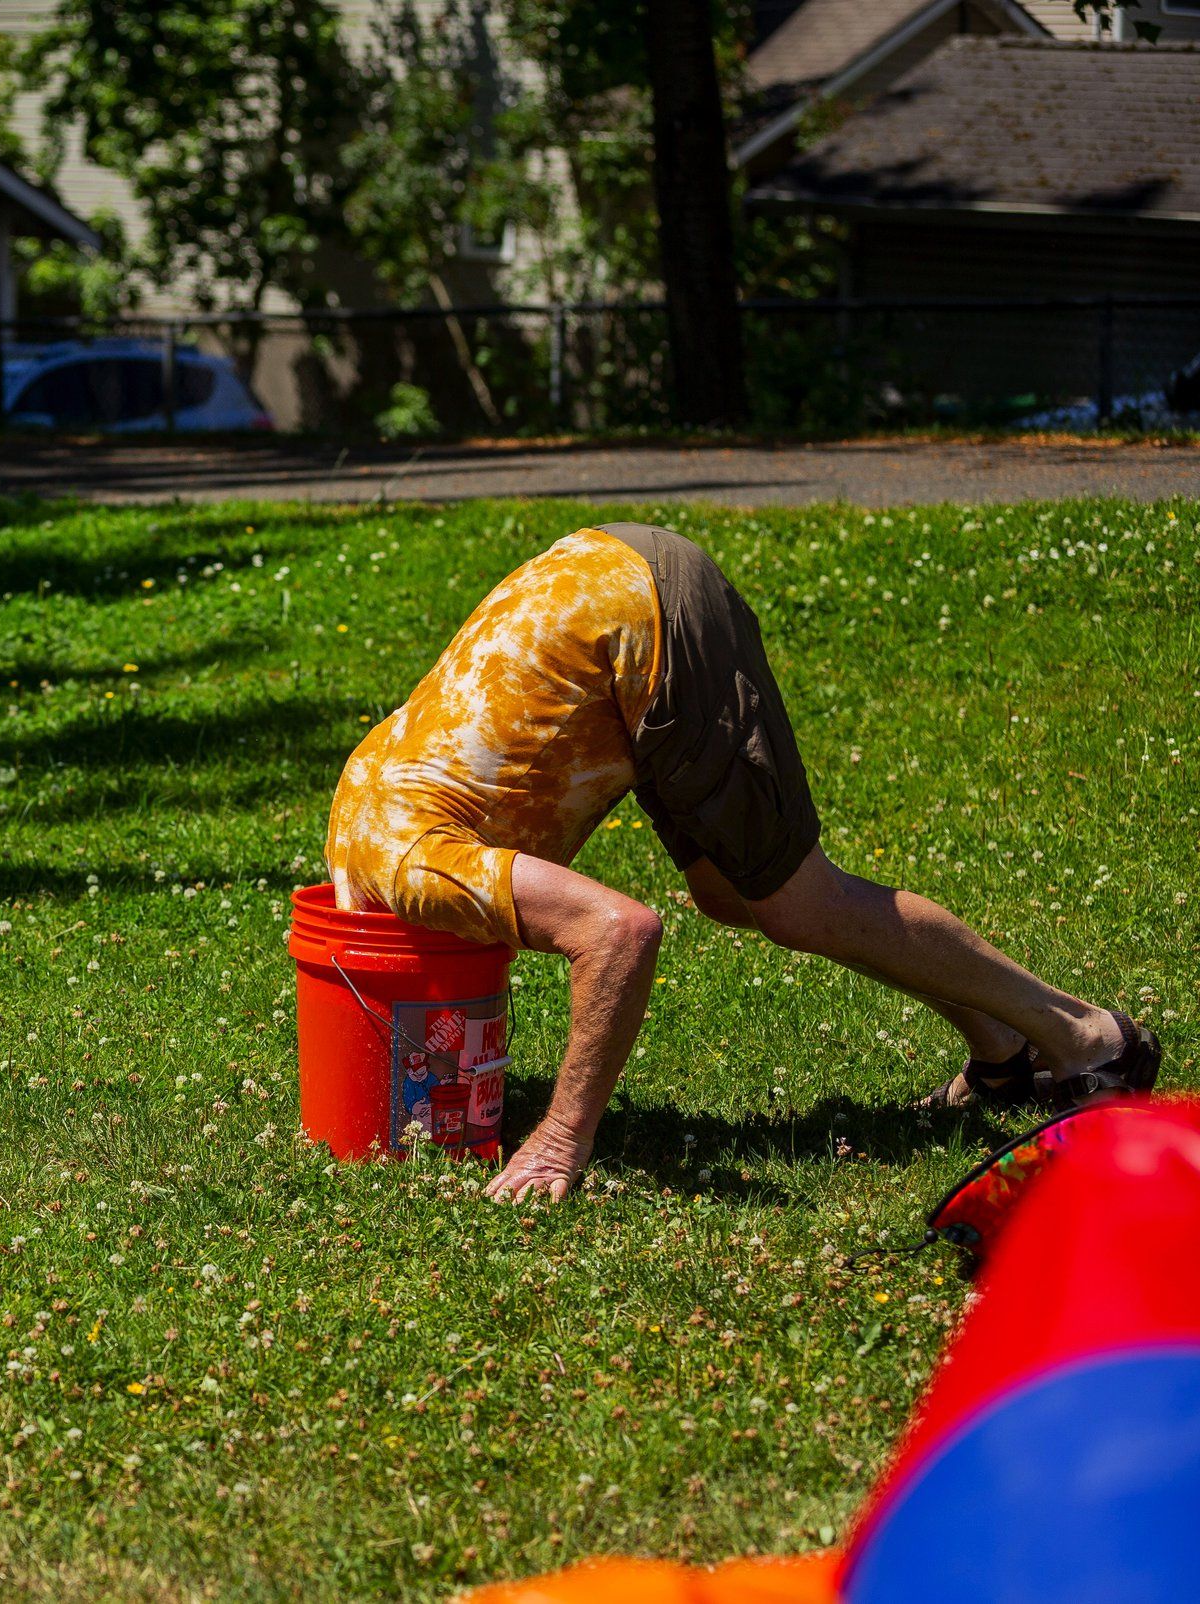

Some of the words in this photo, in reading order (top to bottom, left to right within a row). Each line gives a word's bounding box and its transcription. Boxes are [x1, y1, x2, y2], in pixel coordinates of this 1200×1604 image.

[424, 1010, 462, 1052] HOME
[429, 1013, 446, 1031] THE
[439, 1017, 465, 1052] DEPOT
